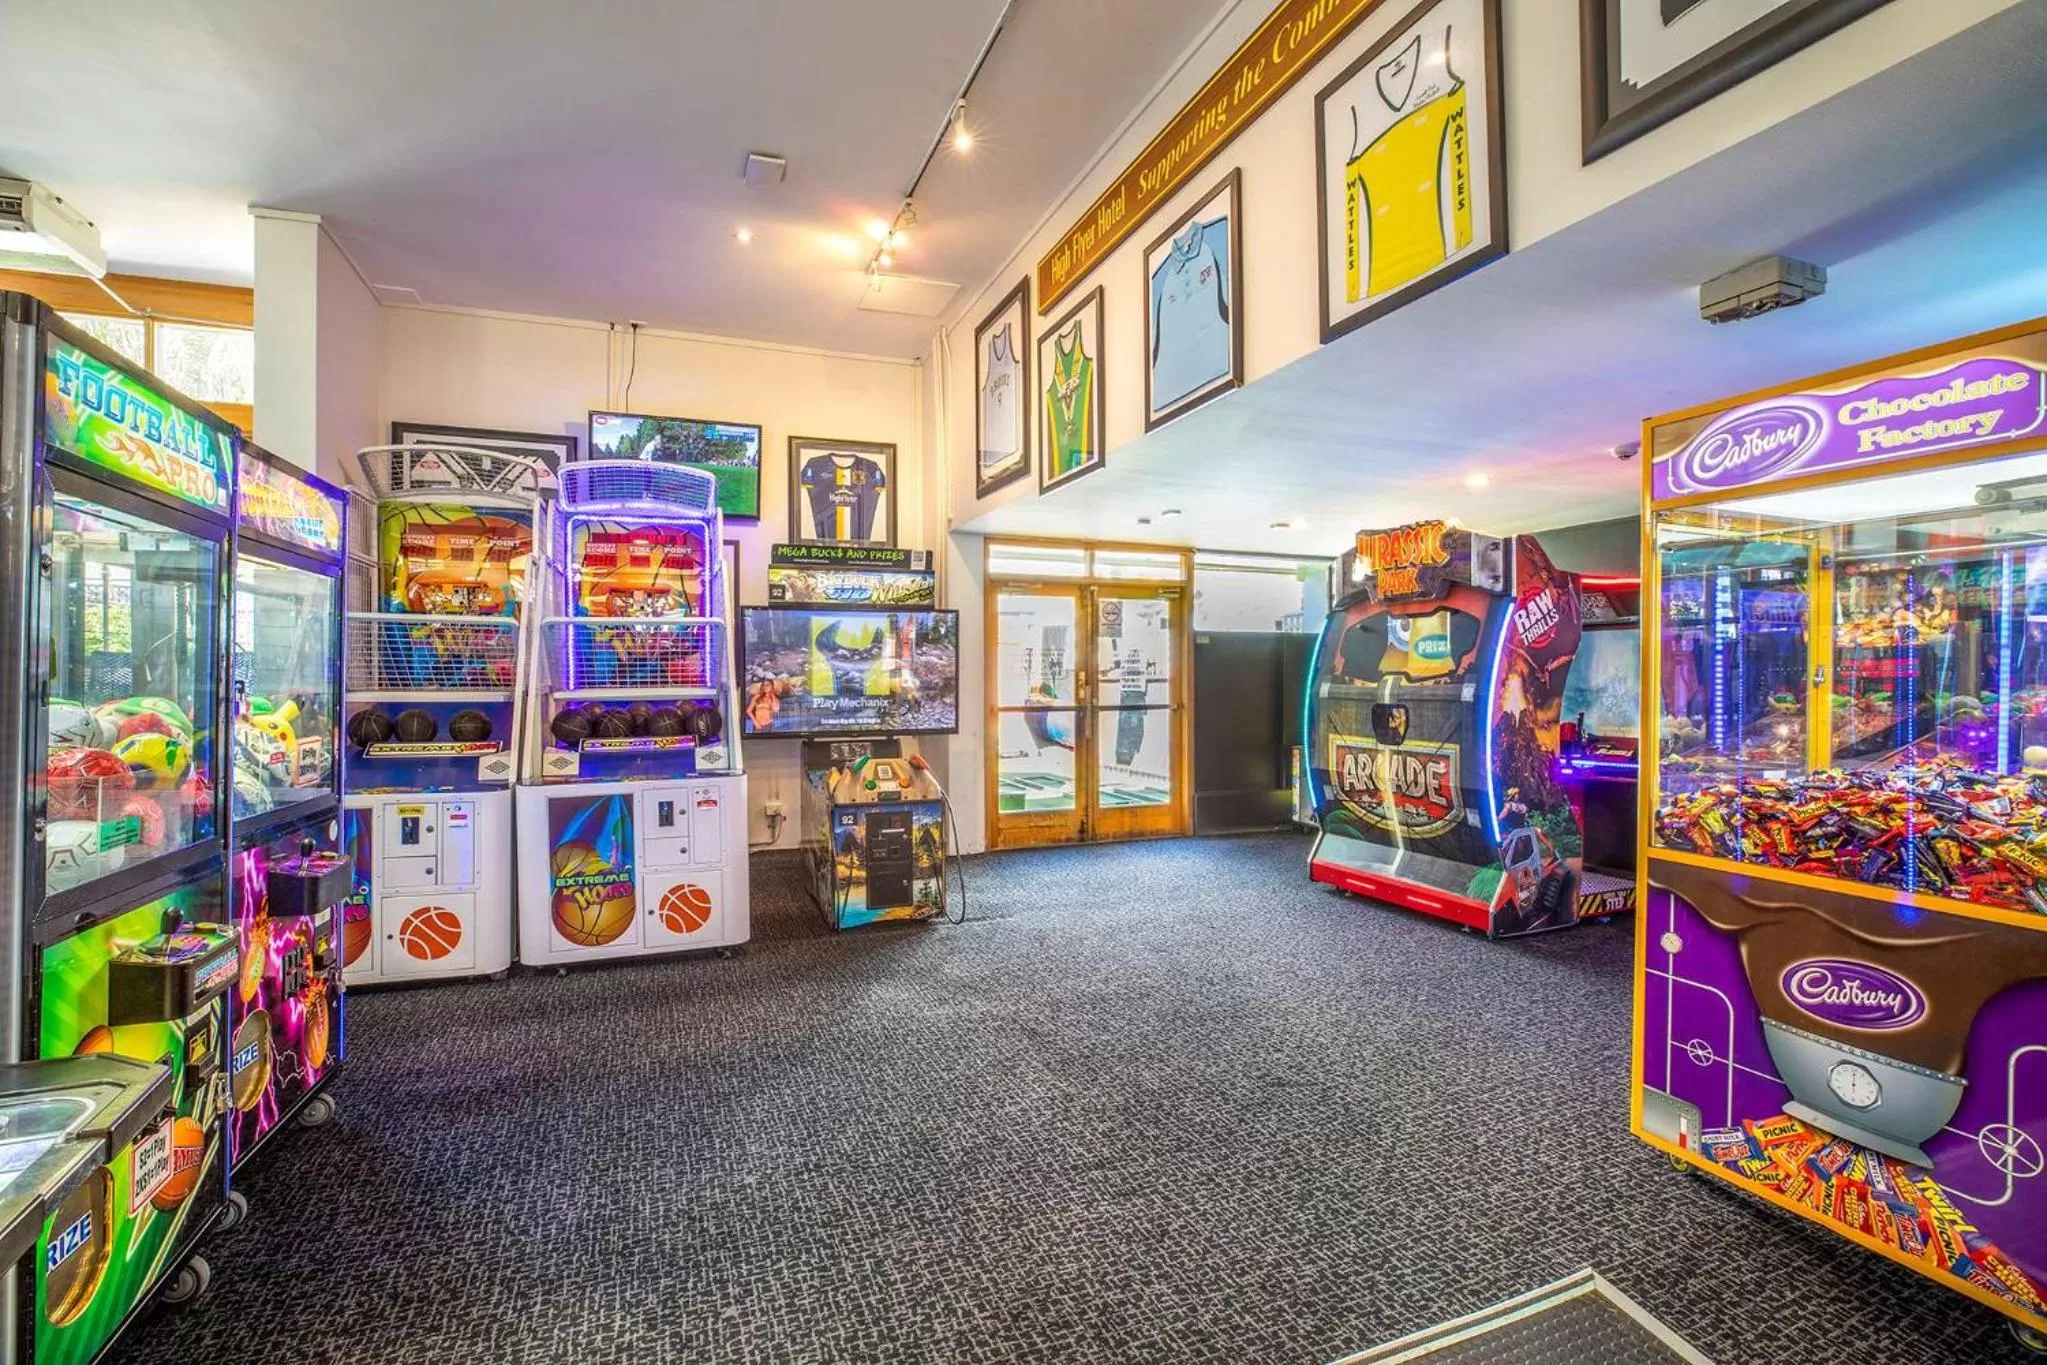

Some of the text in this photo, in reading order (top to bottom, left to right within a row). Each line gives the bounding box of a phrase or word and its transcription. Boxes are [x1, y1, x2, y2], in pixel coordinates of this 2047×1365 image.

[1051, 245, 1071, 284] High
[1072, 223, 1096, 264] Flyer
[1098, 184, 1126, 239] Hotel
[1138, 97, 1229, 199] Supporting
[1233, 58, 1266, 105] the
[1451, 106, 1466, 212] WATTLES
[1346, 179, 1358, 270] WATTLES
[56, 350, 217, 470] FOOTBALL
[1837, 371, 2030, 427] Chocolate
[1692, 422, 1802, 479] Cadbury
[1857, 409, 2004, 453] Factory
[163, 457, 218, 503] PRO
[778, 547, 806, 556] MEGA
[847, 550, 867, 559] AND
[870, 551, 904, 561] PRIZES
[1377, 567, 1420, 599] PARK
[1514, 588, 1555, 634] RAW
[1521, 608, 1560, 647] THRILLS
[812, 696, 889, 711] Play Mechanix
[1343, 751, 1449, 808] ARCADE
[841, 814, 855, 825] 92
[556, 873, 630, 887] EXTREME
[1789, 966, 1904, 1016] Cadbury
[233, 1042, 258, 1074] RIZE
[1763, 1123, 1800, 1139] PICNIC
[1913, 1175, 1979, 1233] TWIRL
[47, 1211, 92, 1270] RIZE
